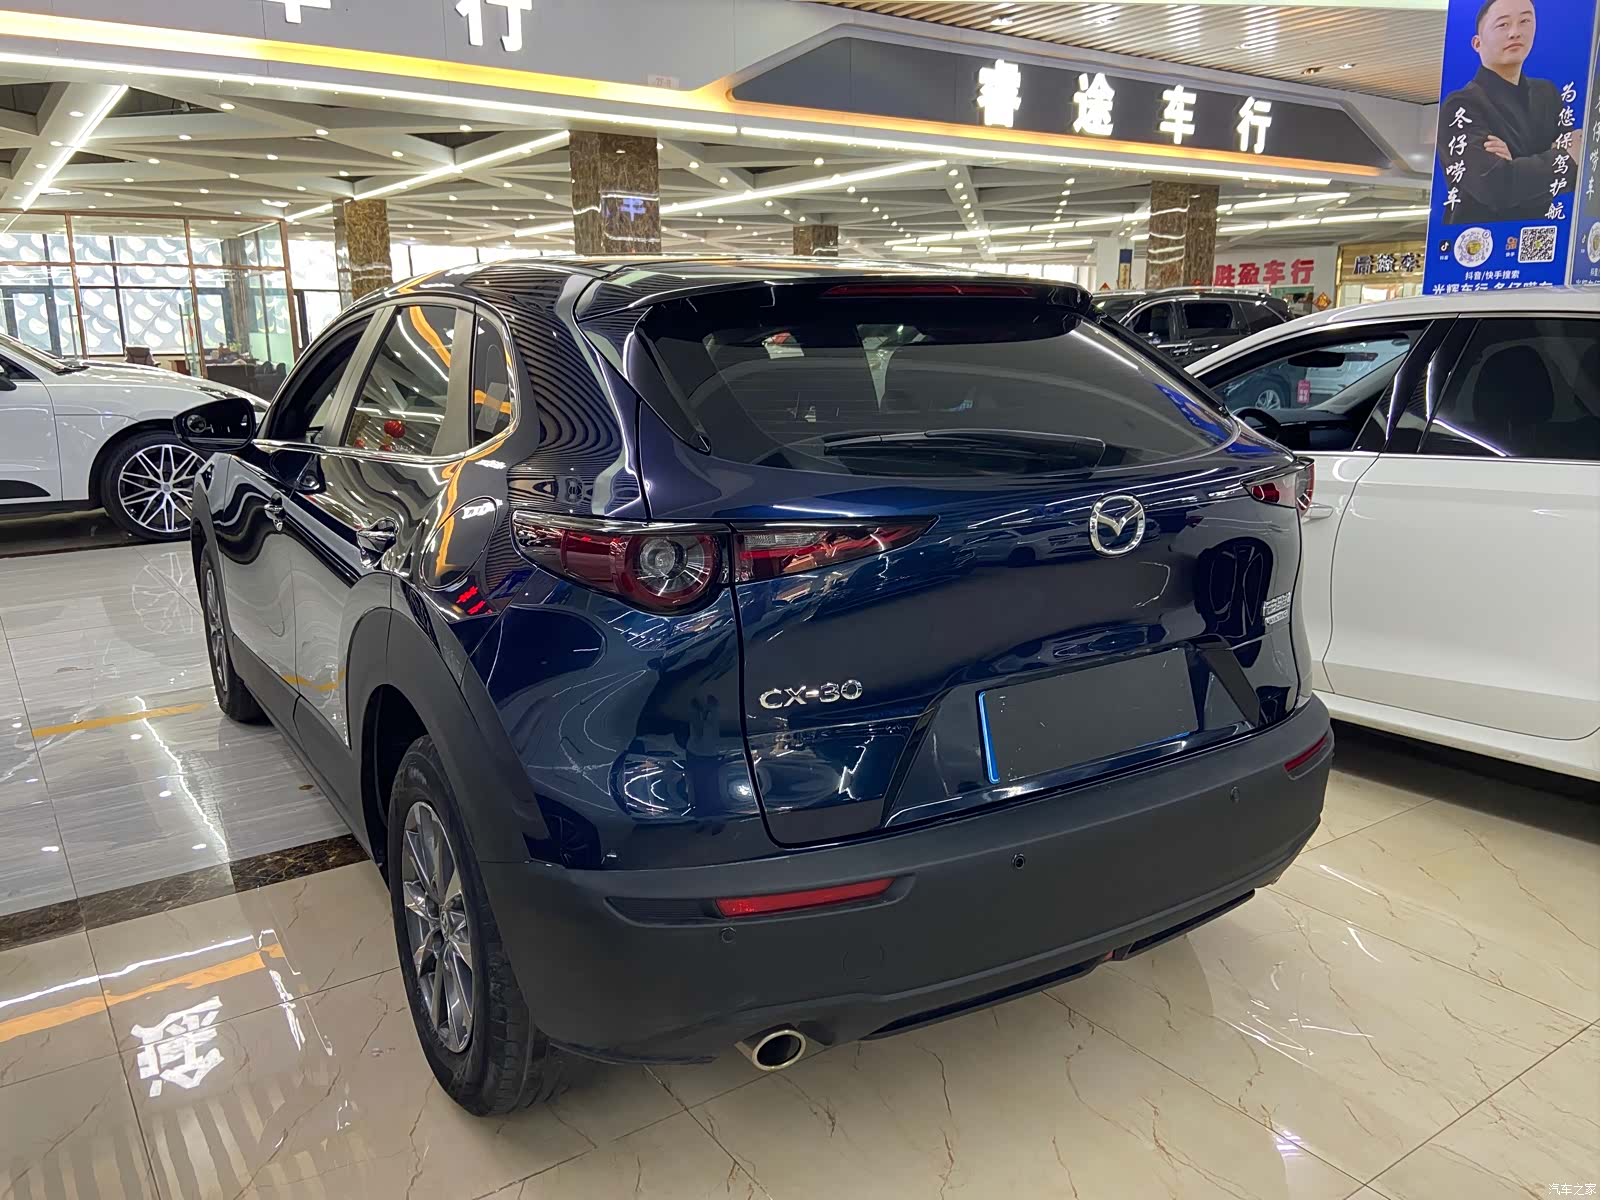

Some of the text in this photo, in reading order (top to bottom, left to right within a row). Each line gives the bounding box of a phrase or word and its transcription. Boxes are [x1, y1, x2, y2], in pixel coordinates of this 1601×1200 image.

[1443, 107, 1473, 211] 冬仔唠车
[1545, 81, 1577, 220] 为您保驾护航
[1214, 258, 1315, 288] 胜盈车行
[1464, 269, 1521, 281] 抖音/快手搜索
[759, 679, 863, 709] CX-30
